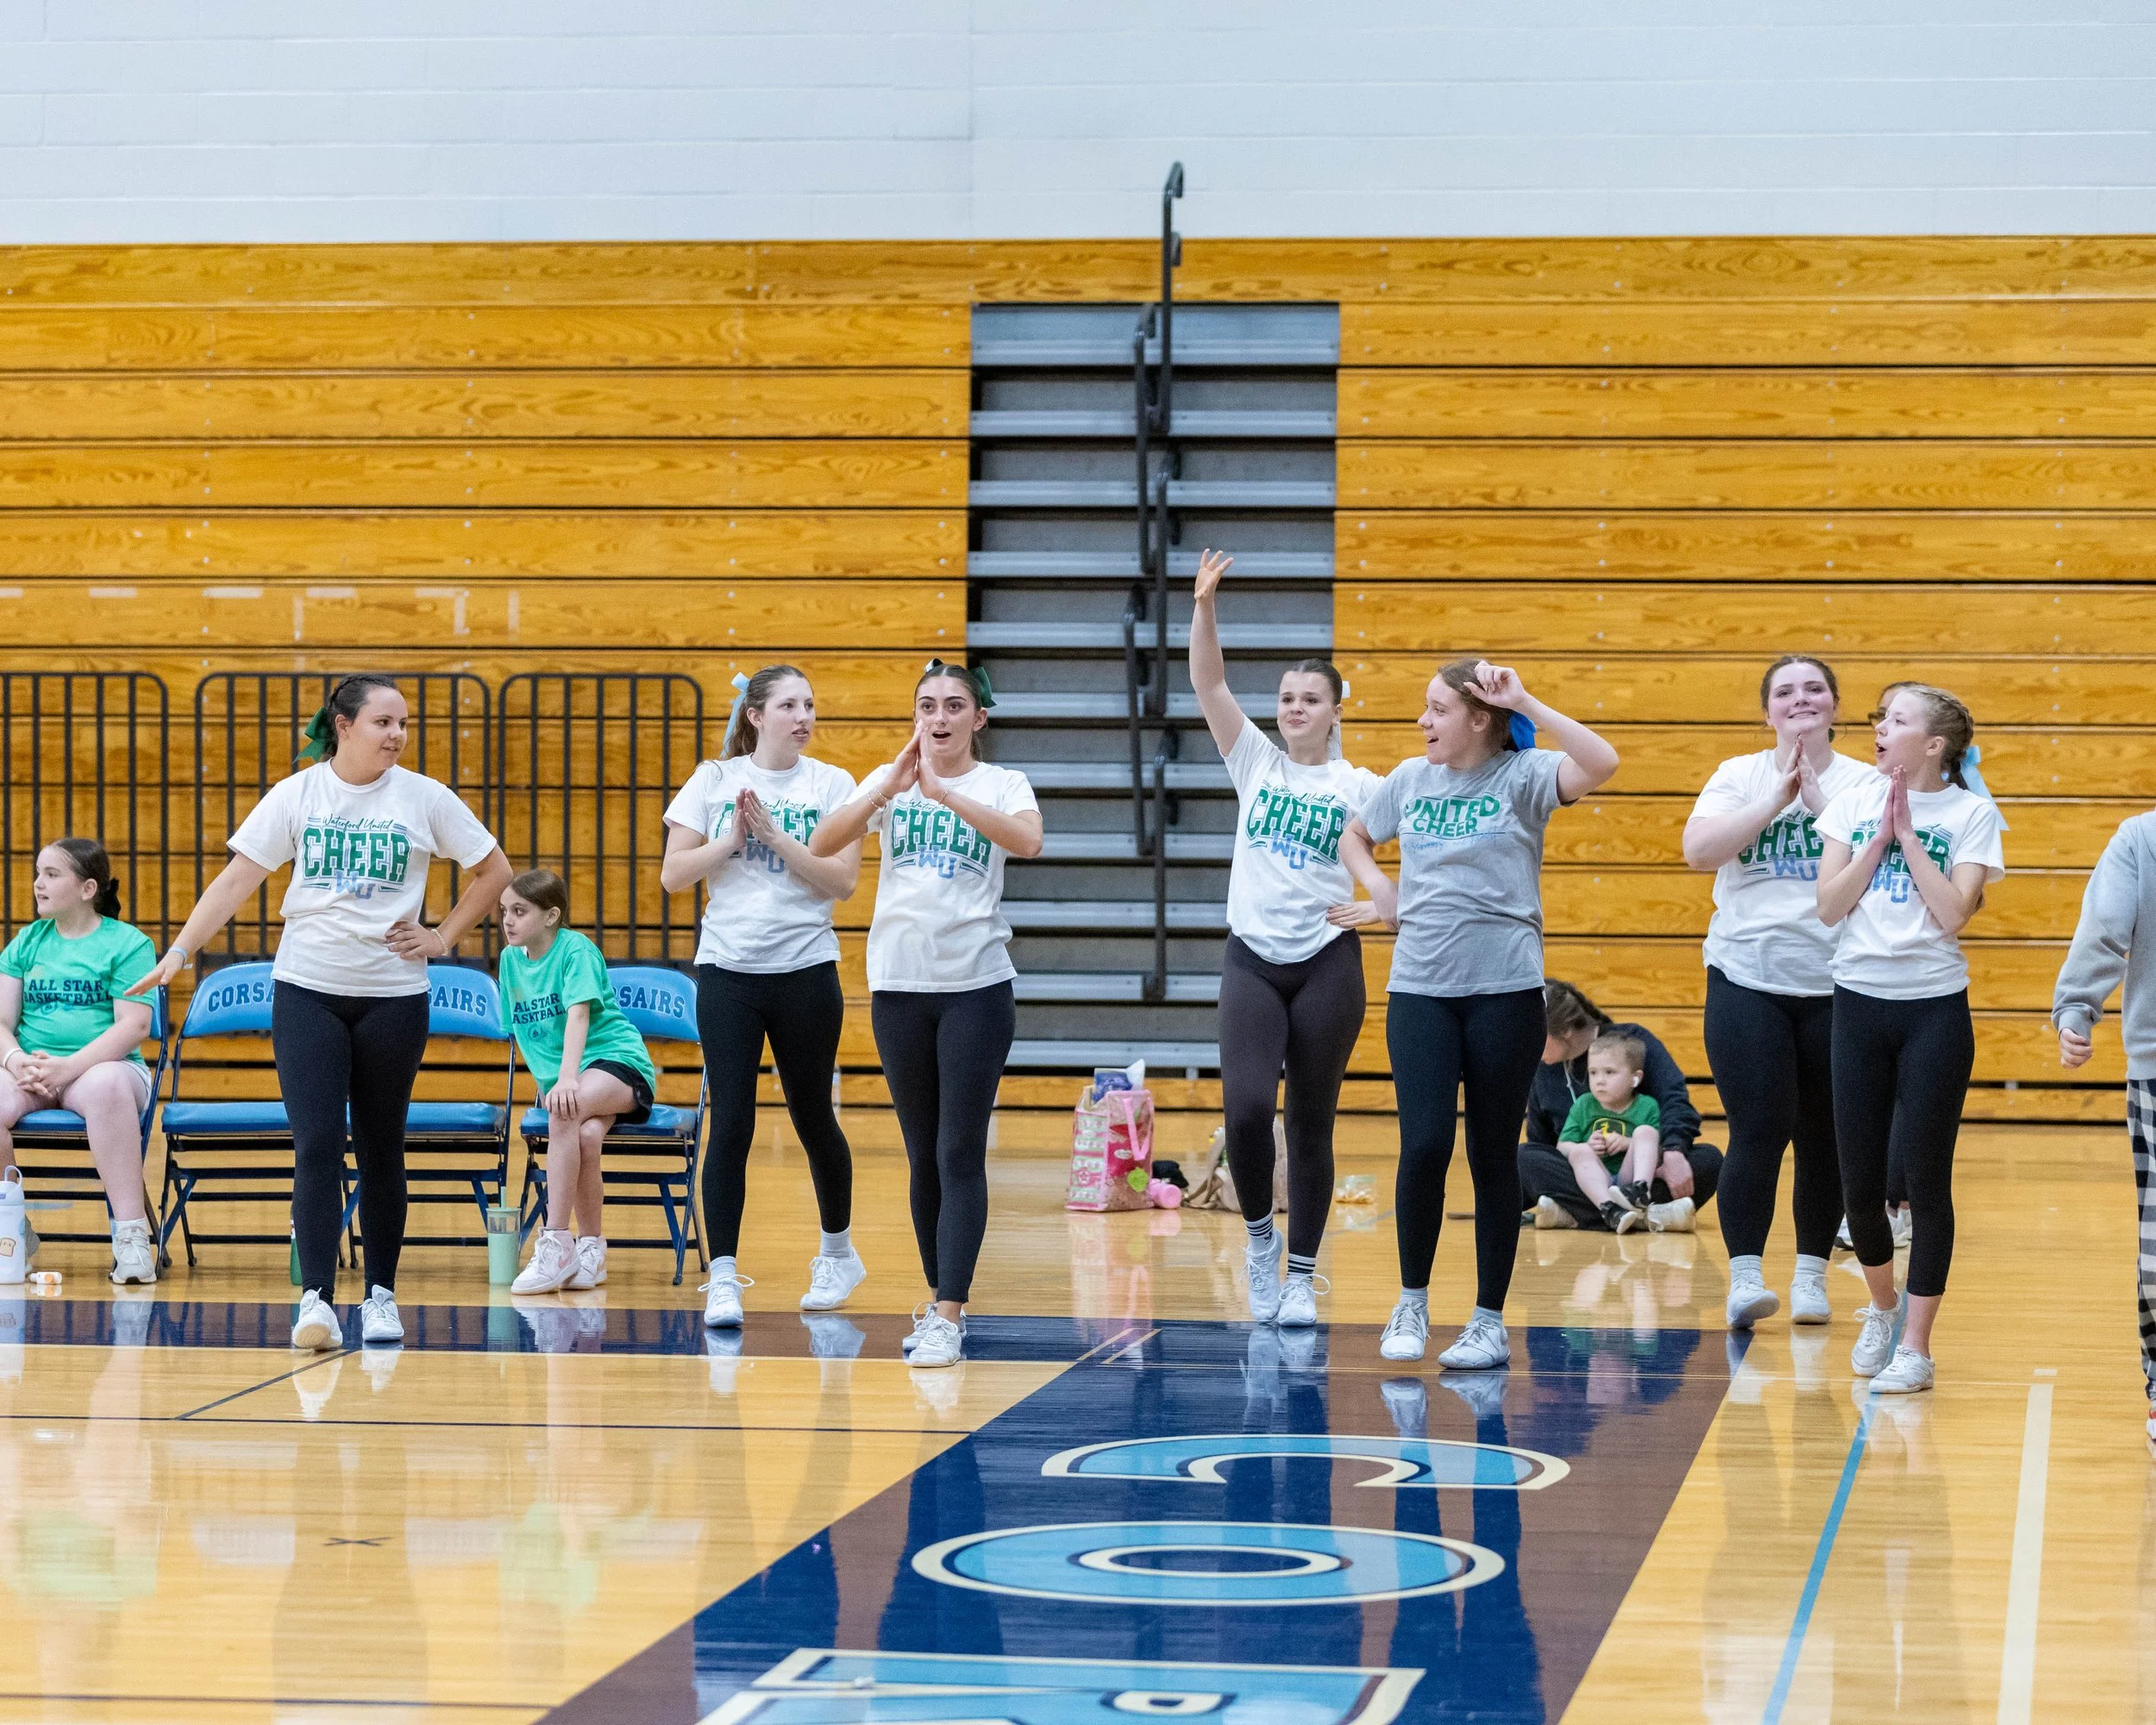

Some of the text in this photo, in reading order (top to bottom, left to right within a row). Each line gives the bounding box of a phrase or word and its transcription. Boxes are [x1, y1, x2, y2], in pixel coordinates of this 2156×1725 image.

[1404, 795, 1501, 823] UNITED
[1248, 788, 1344, 862] CHEER
[1413, 817, 1478, 837] CHEER
[303, 826, 411, 883] CHEER
[918, 844, 957, 879] WU
[1271, 829, 1308, 870] WU
[1769, 854, 1818, 881] WU
[335, 869, 376, 900] WU
[28, 979, 103, 992] ALL STAR
